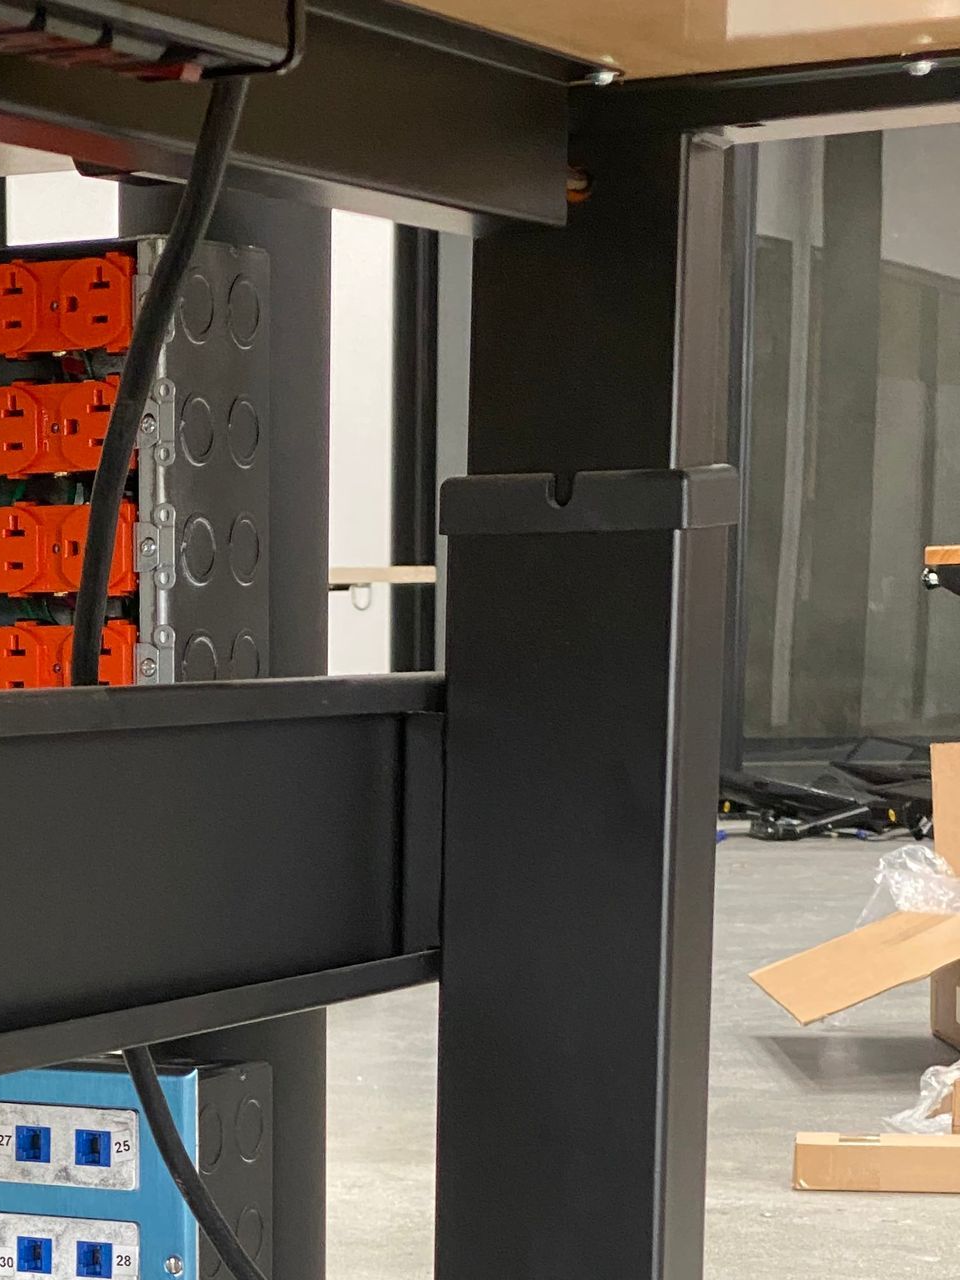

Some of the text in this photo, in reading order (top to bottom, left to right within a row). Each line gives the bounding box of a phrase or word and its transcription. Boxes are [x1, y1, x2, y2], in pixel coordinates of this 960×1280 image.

[114, 1139, 131, 1154] 25
[0, 1255, 15, 1269] 30
[116, 1254, 132, 1268] 28
